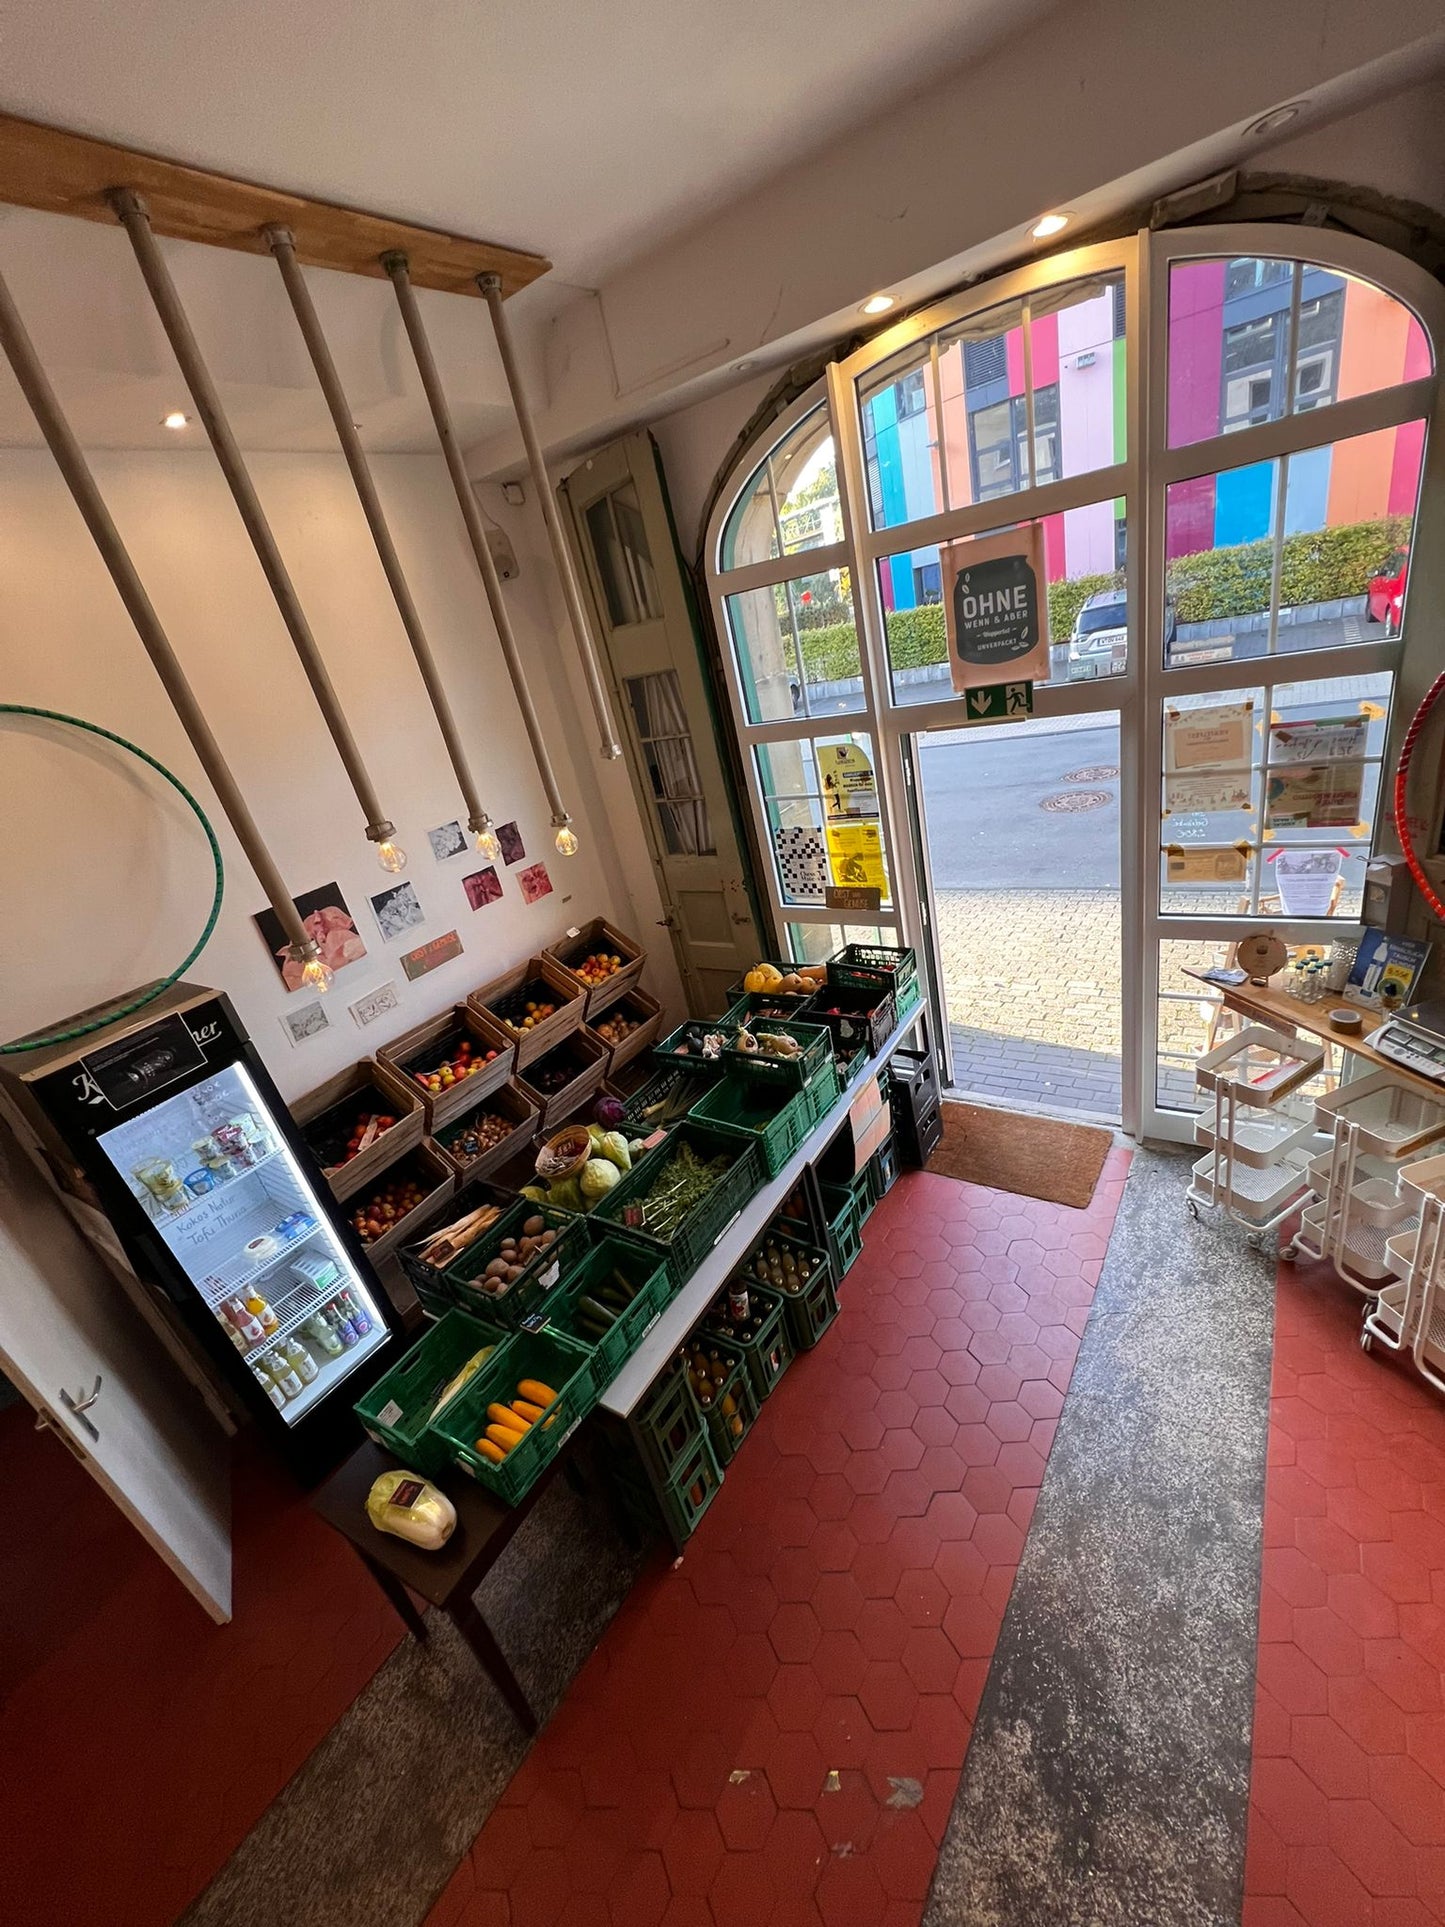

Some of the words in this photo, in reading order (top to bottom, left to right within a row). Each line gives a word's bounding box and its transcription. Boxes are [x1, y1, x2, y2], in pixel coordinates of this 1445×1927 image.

[962, 585, 1028, 619] OHNE
[964, 617, 990, 629] WENN
[994, 615, 1000, 624] &
[1003, 609, 1028, 622] ABER
[977, 638, 1017, 651] UNVERPACKT
[176, 1210, 209, 1234] Kokos
[187, 1226, 216, 1246] Tofu
